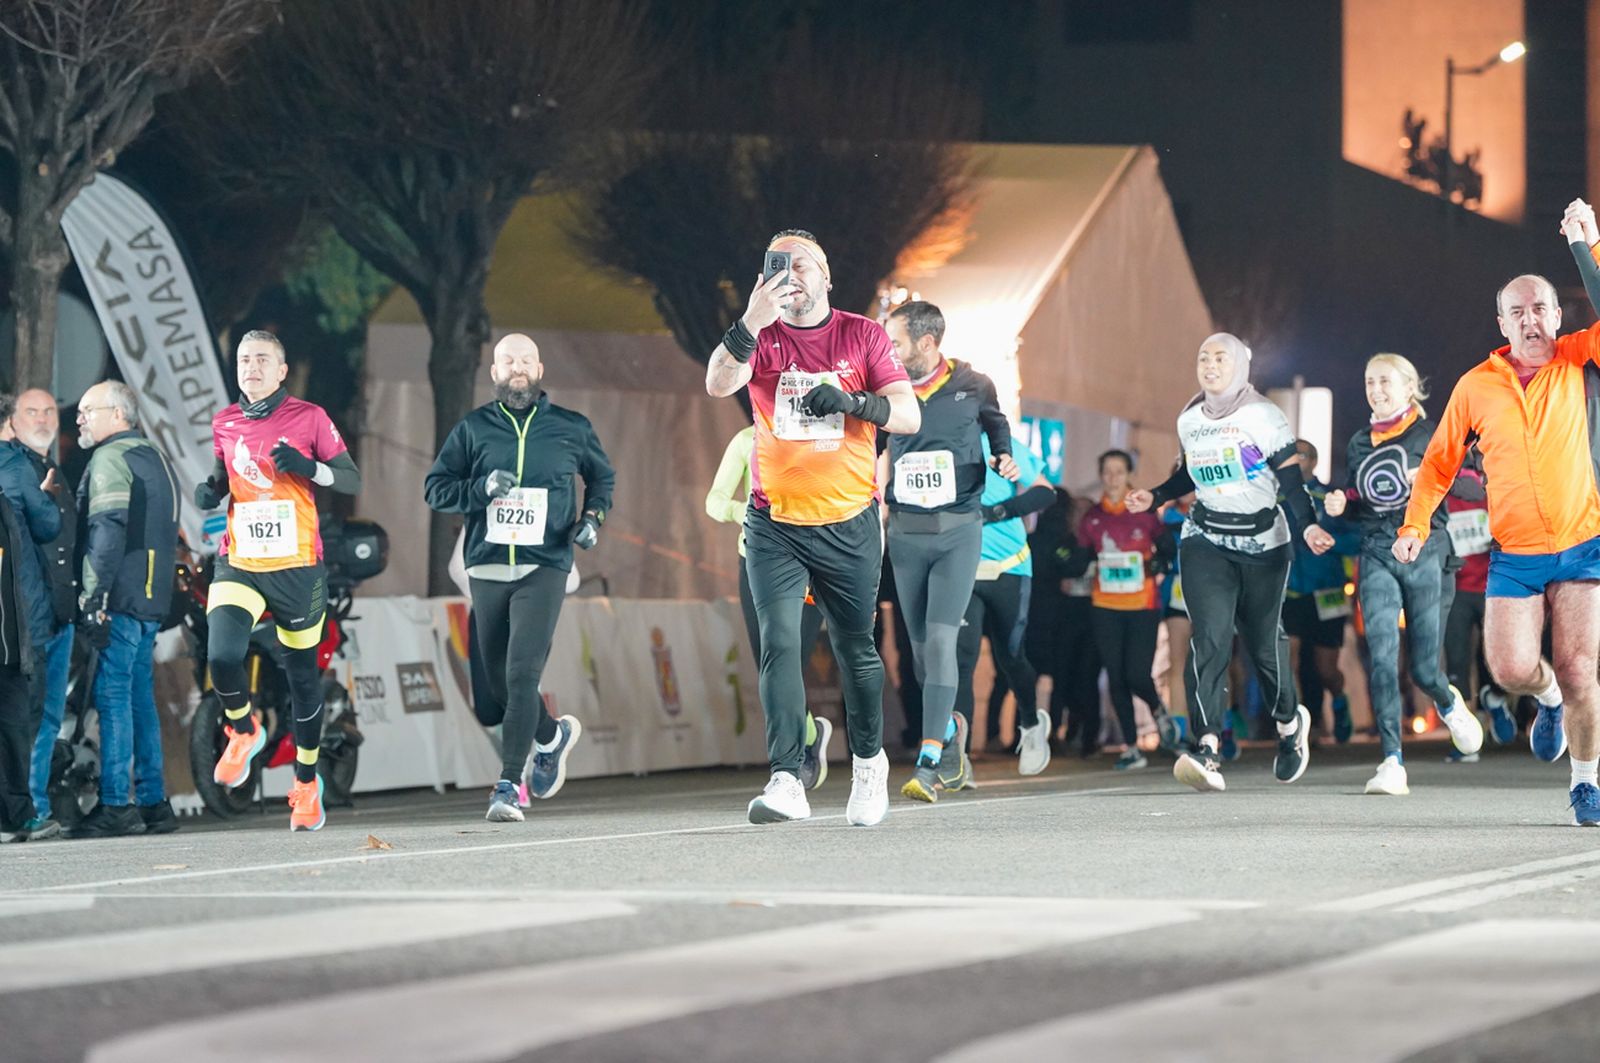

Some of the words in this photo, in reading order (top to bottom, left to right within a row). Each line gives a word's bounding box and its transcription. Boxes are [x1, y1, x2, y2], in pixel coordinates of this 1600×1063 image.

[243, 466, 258, 480] 43
[906, 472, 942, 489] 6619
[1199, 464, 1232, 482] 1091
[496, 508, 535, 525] 6226
[247, 521, 282, 539] 1621
